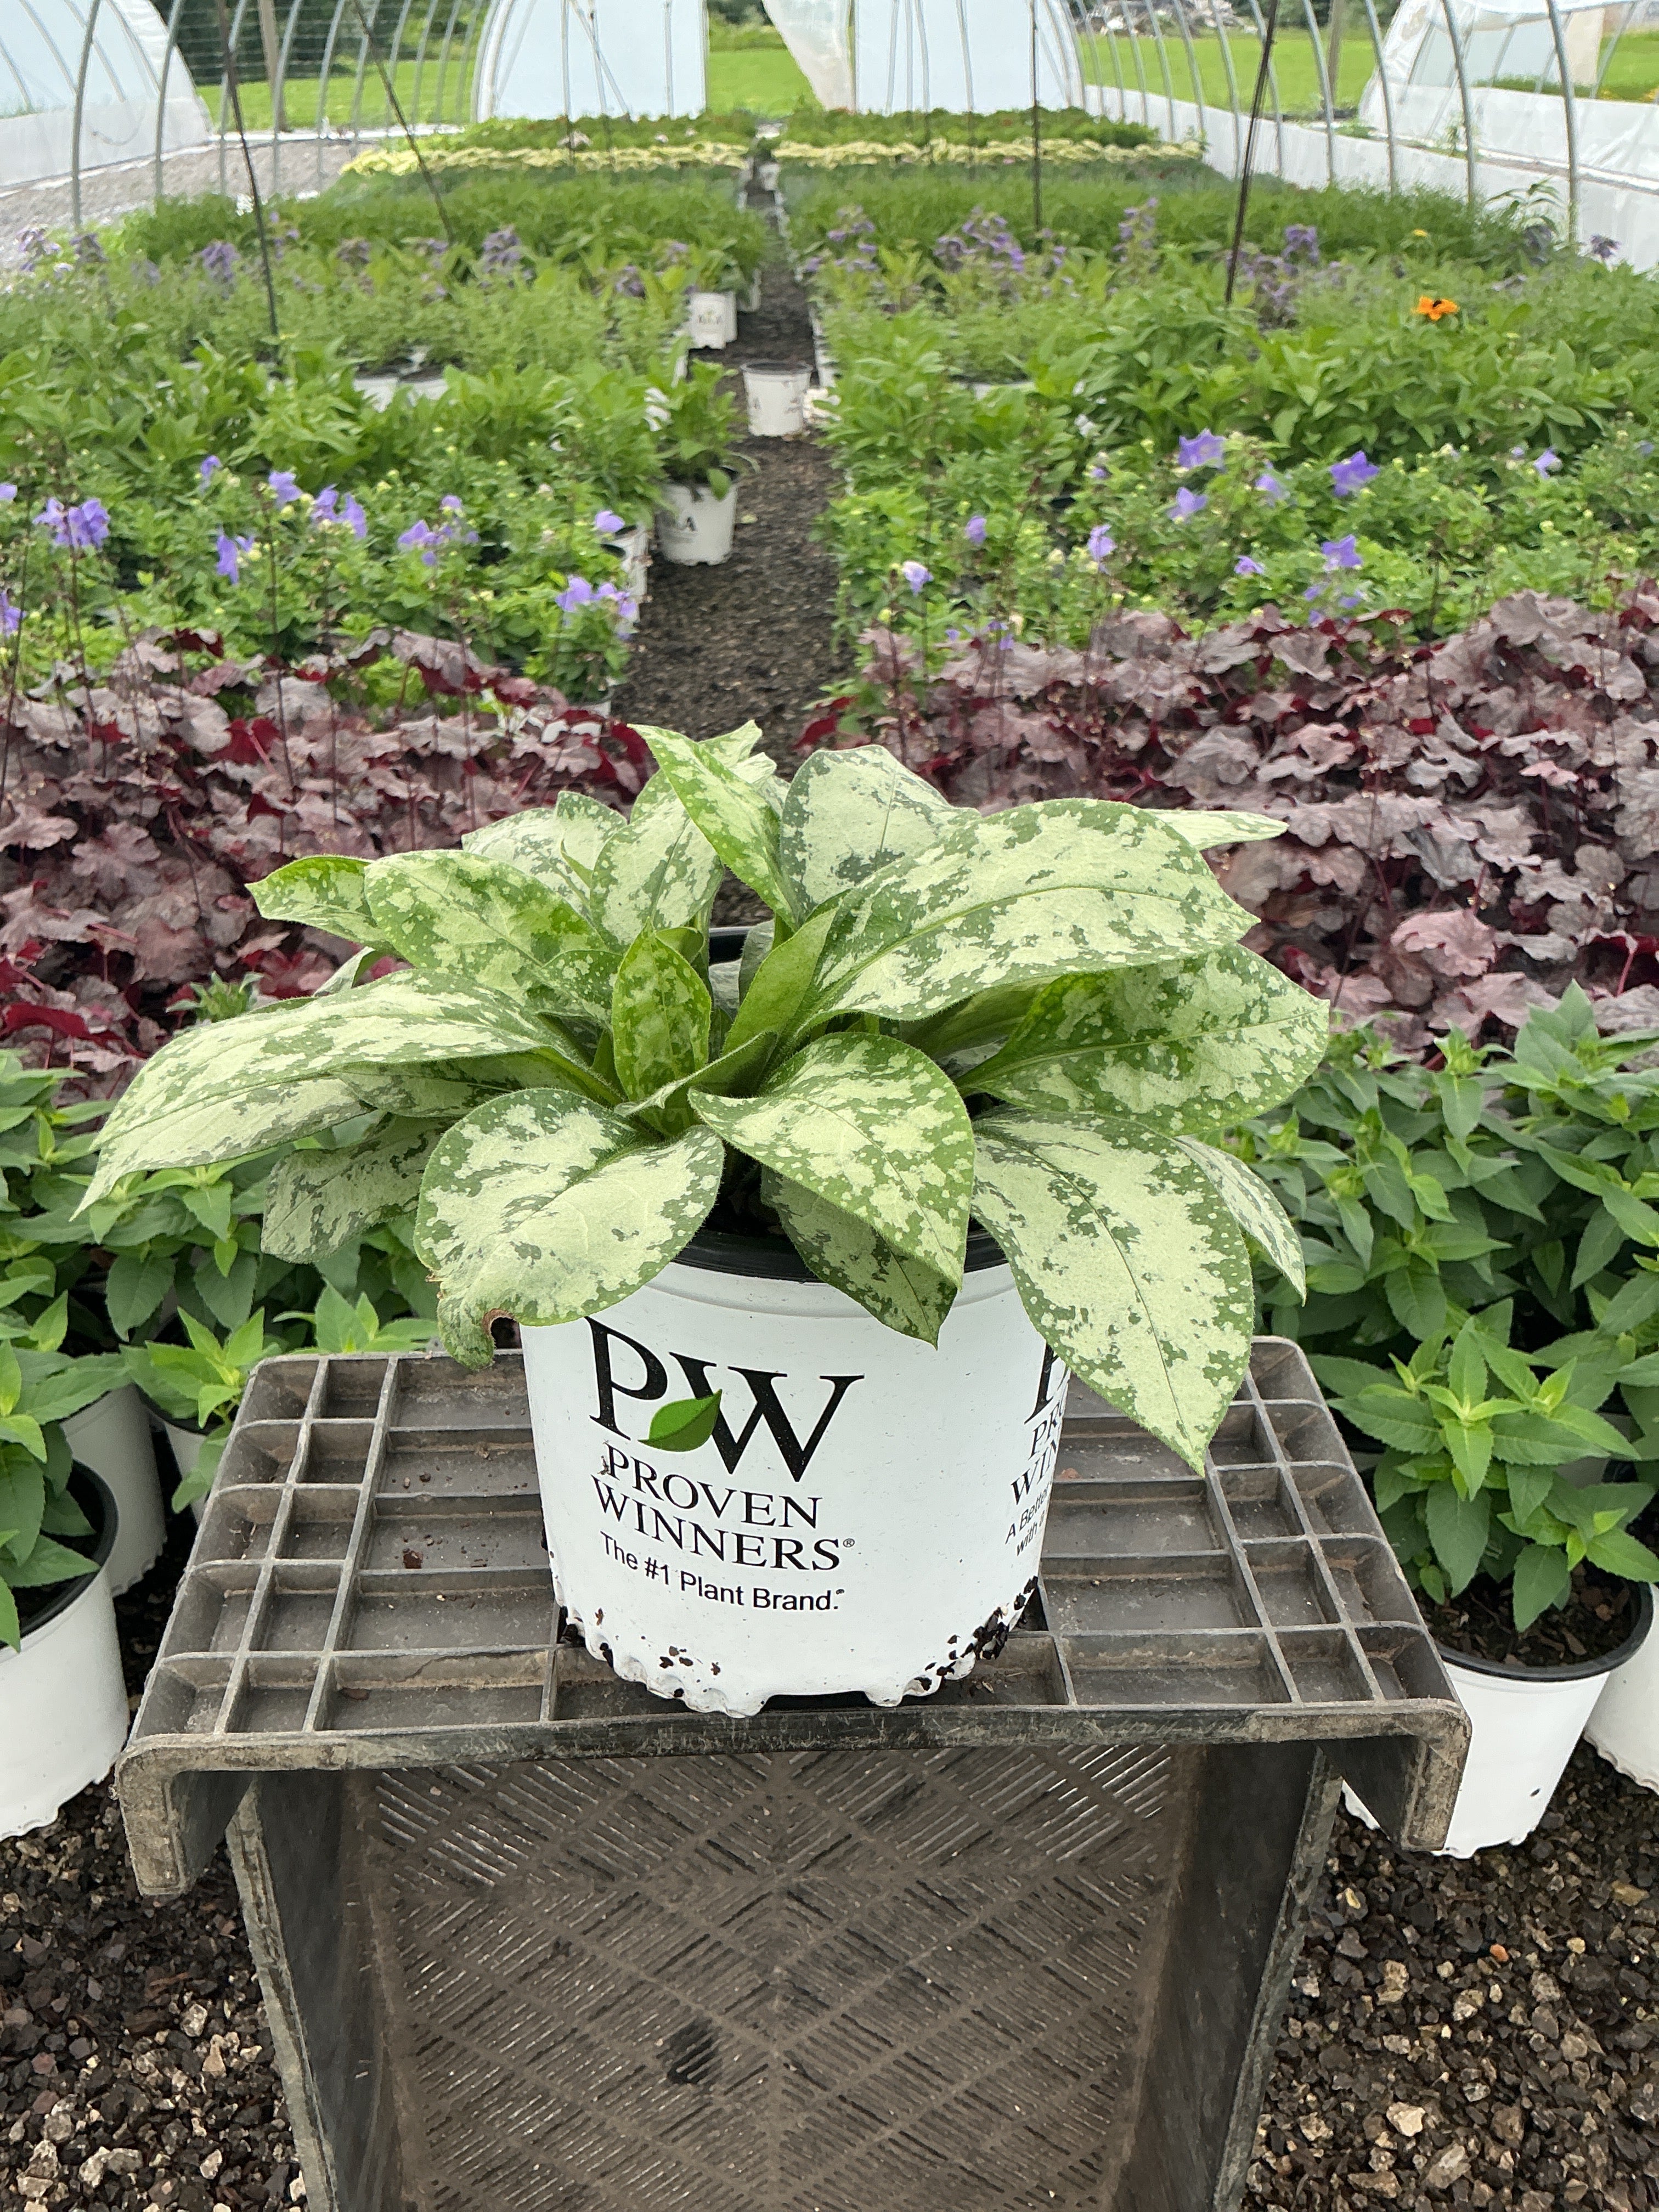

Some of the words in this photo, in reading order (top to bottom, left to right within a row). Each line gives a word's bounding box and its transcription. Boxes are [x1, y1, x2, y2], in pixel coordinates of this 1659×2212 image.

[584, 1316, 865, 1482] PW
[605, 1442, 822, 1529] PROVEN
[600, 1531, 638, 1571] The
[644, 1556, 670, 1585] #1
[680, 1571, 744, 1606] Plant
[1005, 1522, 1015, 1544] A
[1017, 1521, 1037, 1556] with
